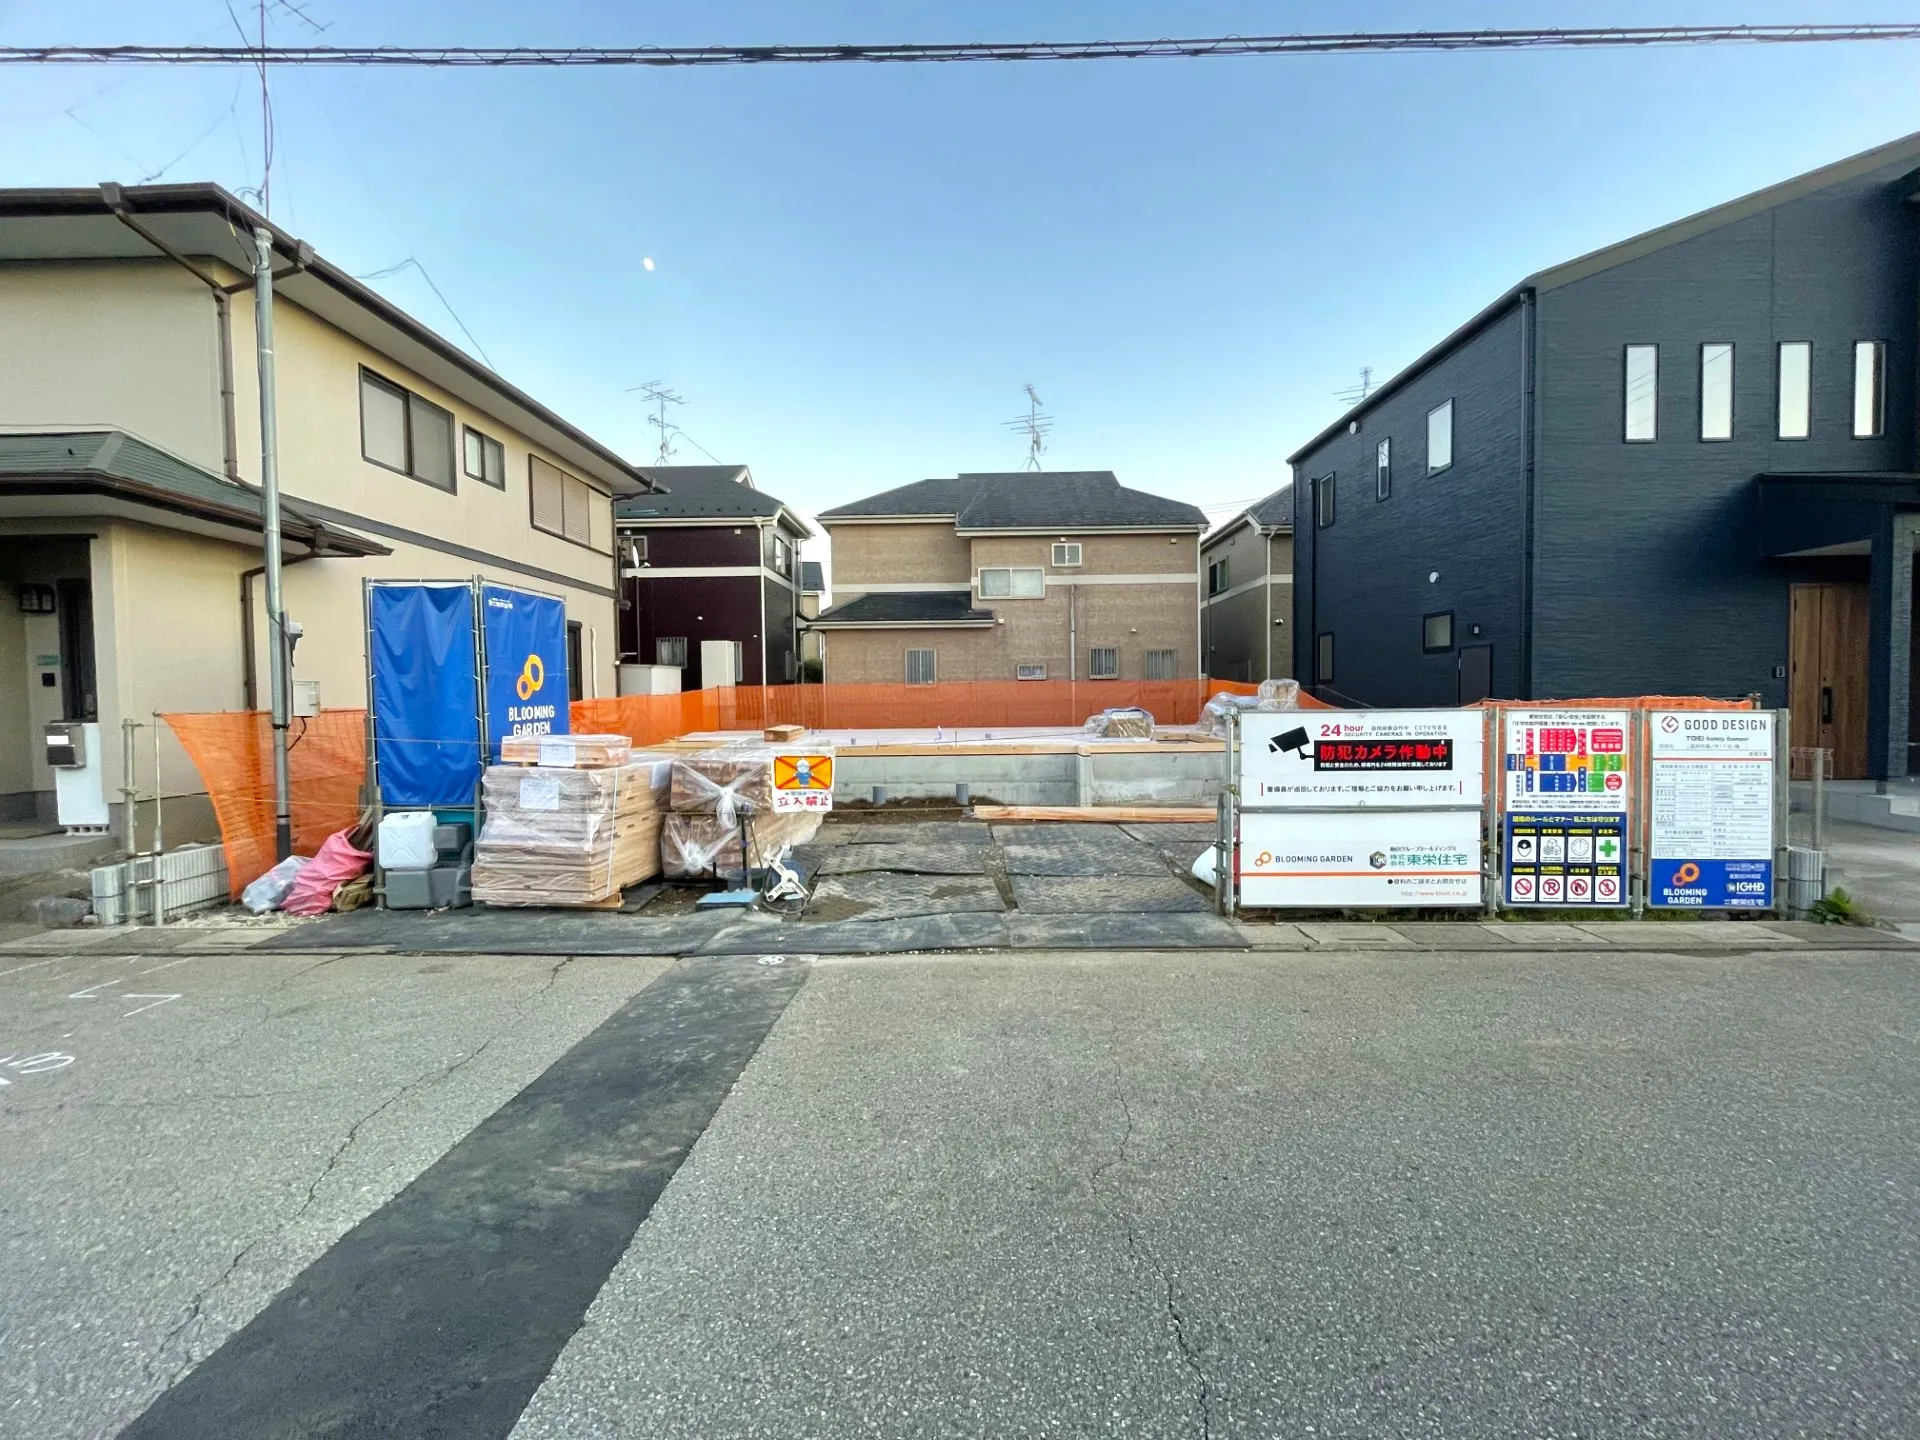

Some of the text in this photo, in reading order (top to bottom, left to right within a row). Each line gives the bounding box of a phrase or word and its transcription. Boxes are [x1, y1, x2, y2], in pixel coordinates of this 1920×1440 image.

[508, 705, 555, 722] BLOOMING
[513, 721, 551, 737] GARDEN
[1320, 724, 1342, 737] 24
[1684, 719, 1767, 730] GOOD DESIGN
[1320, 743, 1448, 761] 防犯カメラ作動中
[777, 796, 829, 807] 立入禁止
[1275, 855, 1353, 863] BLOOMING GARDEN
[1406, 853, 1468, 866] 東栄住宅
[1663, 888, 1708, 896] BLOOMING
[1667, 896, 1703, 905] GARDEN
